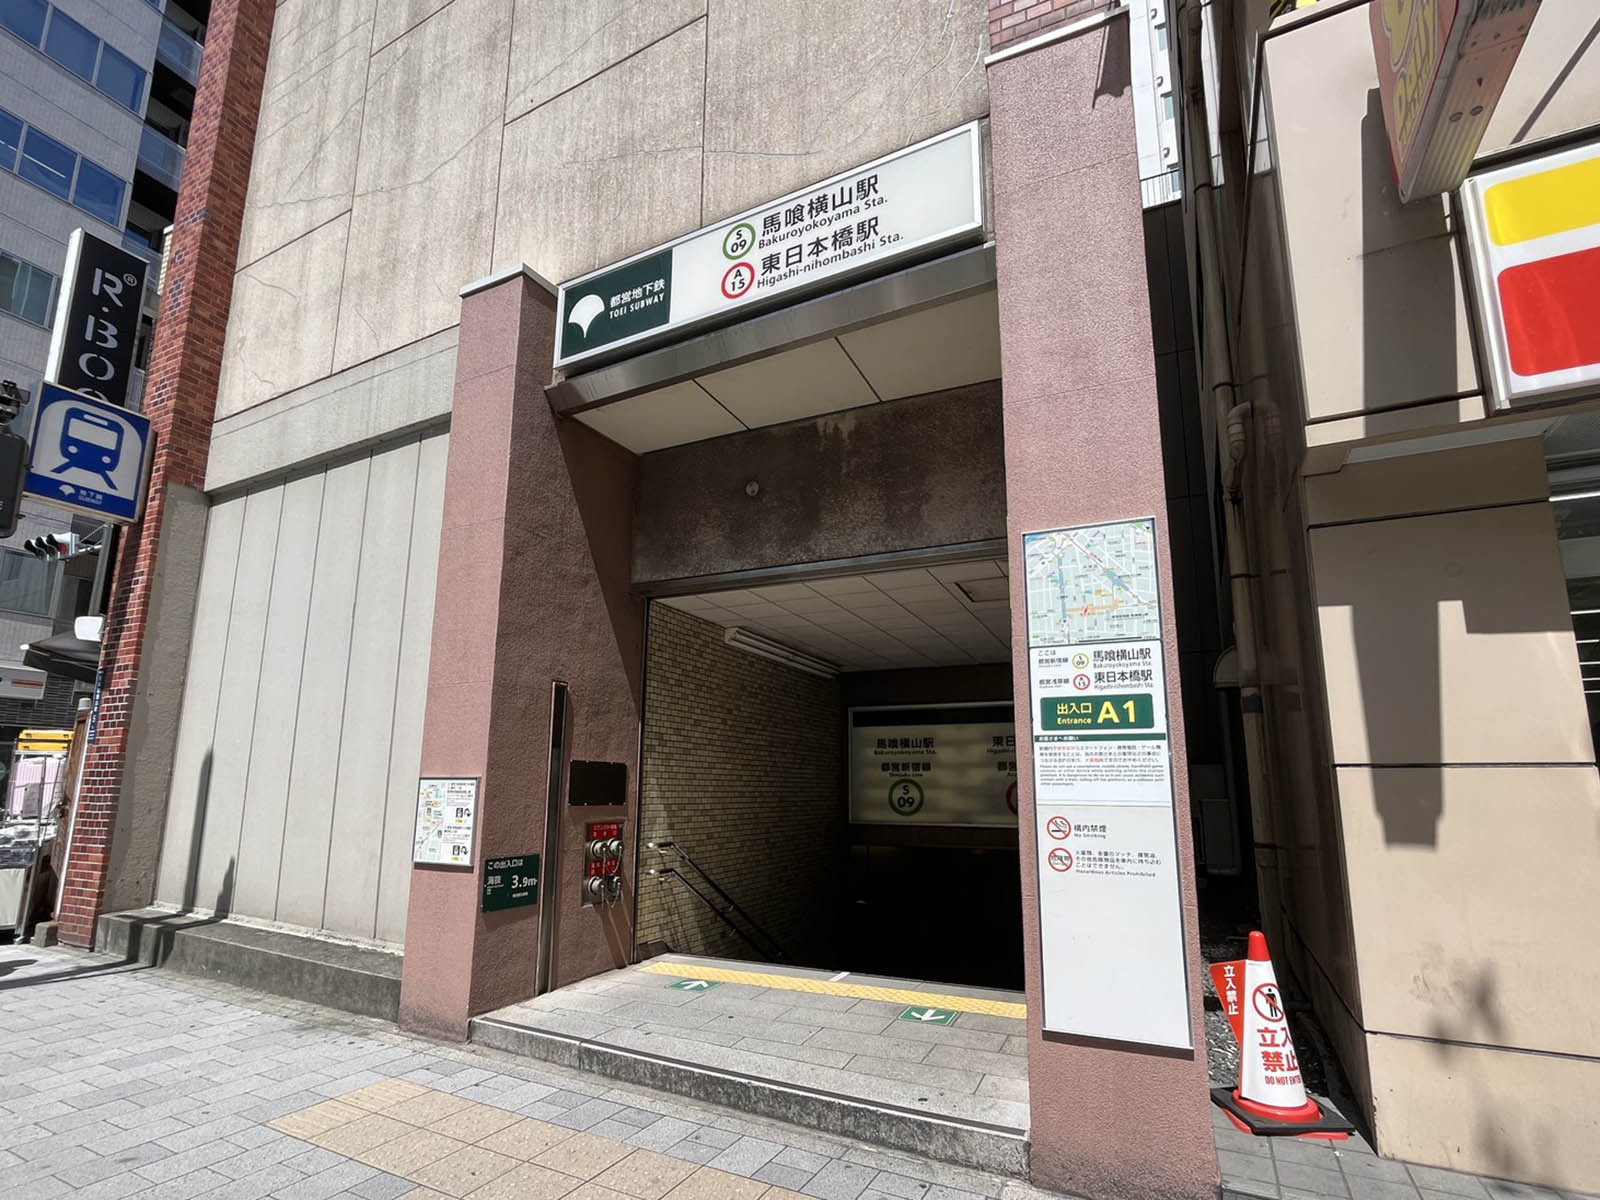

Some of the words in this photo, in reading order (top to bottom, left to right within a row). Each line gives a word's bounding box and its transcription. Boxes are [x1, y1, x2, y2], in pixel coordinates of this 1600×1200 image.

[762, 173, 879, 237] 馬喰横山駅
[758, 206, 860, 250] Bakuroyokoyama
[864, 198, 888, 210] Sta.
[736, 230, 743, 240] S
[731, 239, 747, 253] 09
[761, 216, 879, 276] 東日本橋駅
[757, 240, 876, 289] Higashi-nihombashi
[879, 234, 904, 247] Sta.
[734, 269, 742, 279] A
[731, 278, 745, 292] 15
[610, 278, 665, 308] 都営地下鉄
[609, 305, 627, 319] TOEI
[629, 293, 664, 312] SUBWAY
[1093, 648, 1152, 662] 馬喰横山駅
[1094, 669, 1153, 684] 東日本橋駅
[1056, 702, 1092, 714] 出入口
[1097, 700, 1136, 724] A1
[1057, 717, 1092, 725] Entrance
[876, 737, 935, 749] 馬喰横山駅
[902, 784, 910, 795] S
[897, 796, 915, 808] 09
[1074, 824, 1107, 833] 構内禁煙
[1223, 965, 1239, 1015] 立入禁止
[1257, 1027, 1294, 1048] 立入
[1261, 1051, 1299, 1073] 禁止
[1264, 1075, 1275, 1085] DO
[1276, 1076, 1288, 1086] NOT
